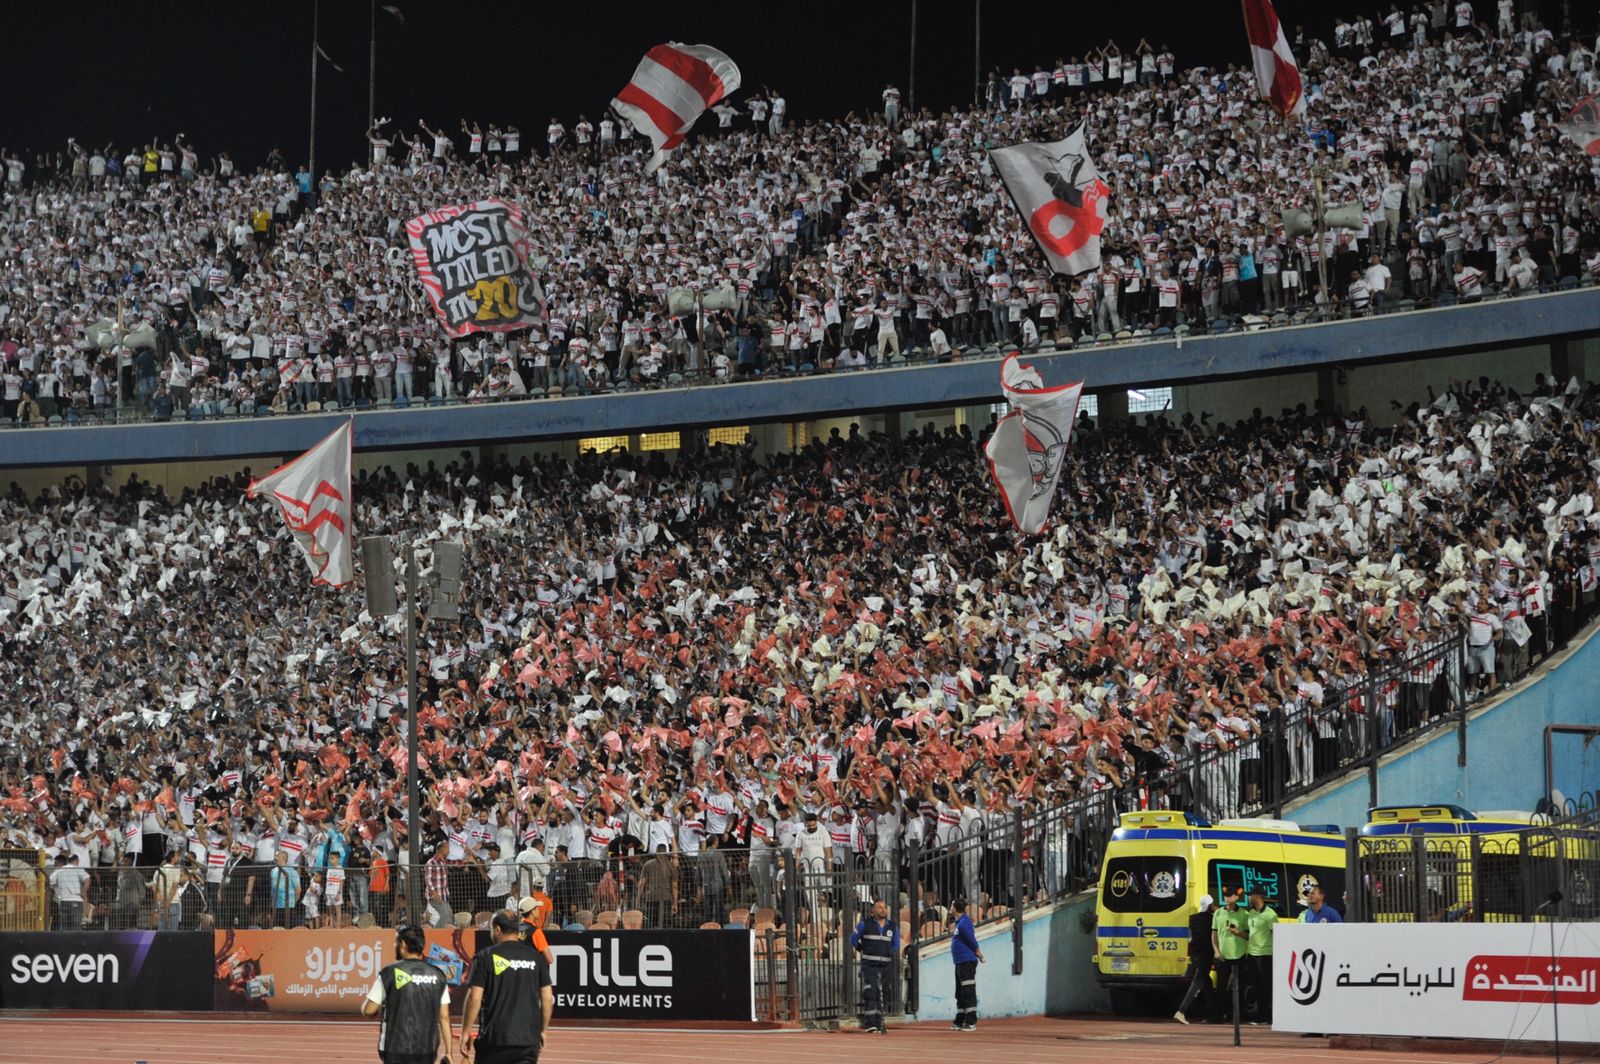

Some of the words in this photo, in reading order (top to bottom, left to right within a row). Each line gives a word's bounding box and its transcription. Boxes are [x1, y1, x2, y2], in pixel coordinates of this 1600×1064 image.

[426, 212, 505, 264] MOST
[445, 291, 478, 324] IN
[1246, 867, 1278, 885] حياة
[1160, 941, 1178, 951] 123
[11, 953, 119, 984] seven
[305, 940, 382, 982] أونيرو
[510, 959, 536, 971] sport
[411, 974, 438, 986] sport
[1336, 962, 1455, 997] للرياضة
[1472, 962, 1596, 993] المتحدة
[286, 983, 313, 996] الزمالك
[315, 983, 337, 998] لنادي
[338, 983, 369, 998] الرسمي
